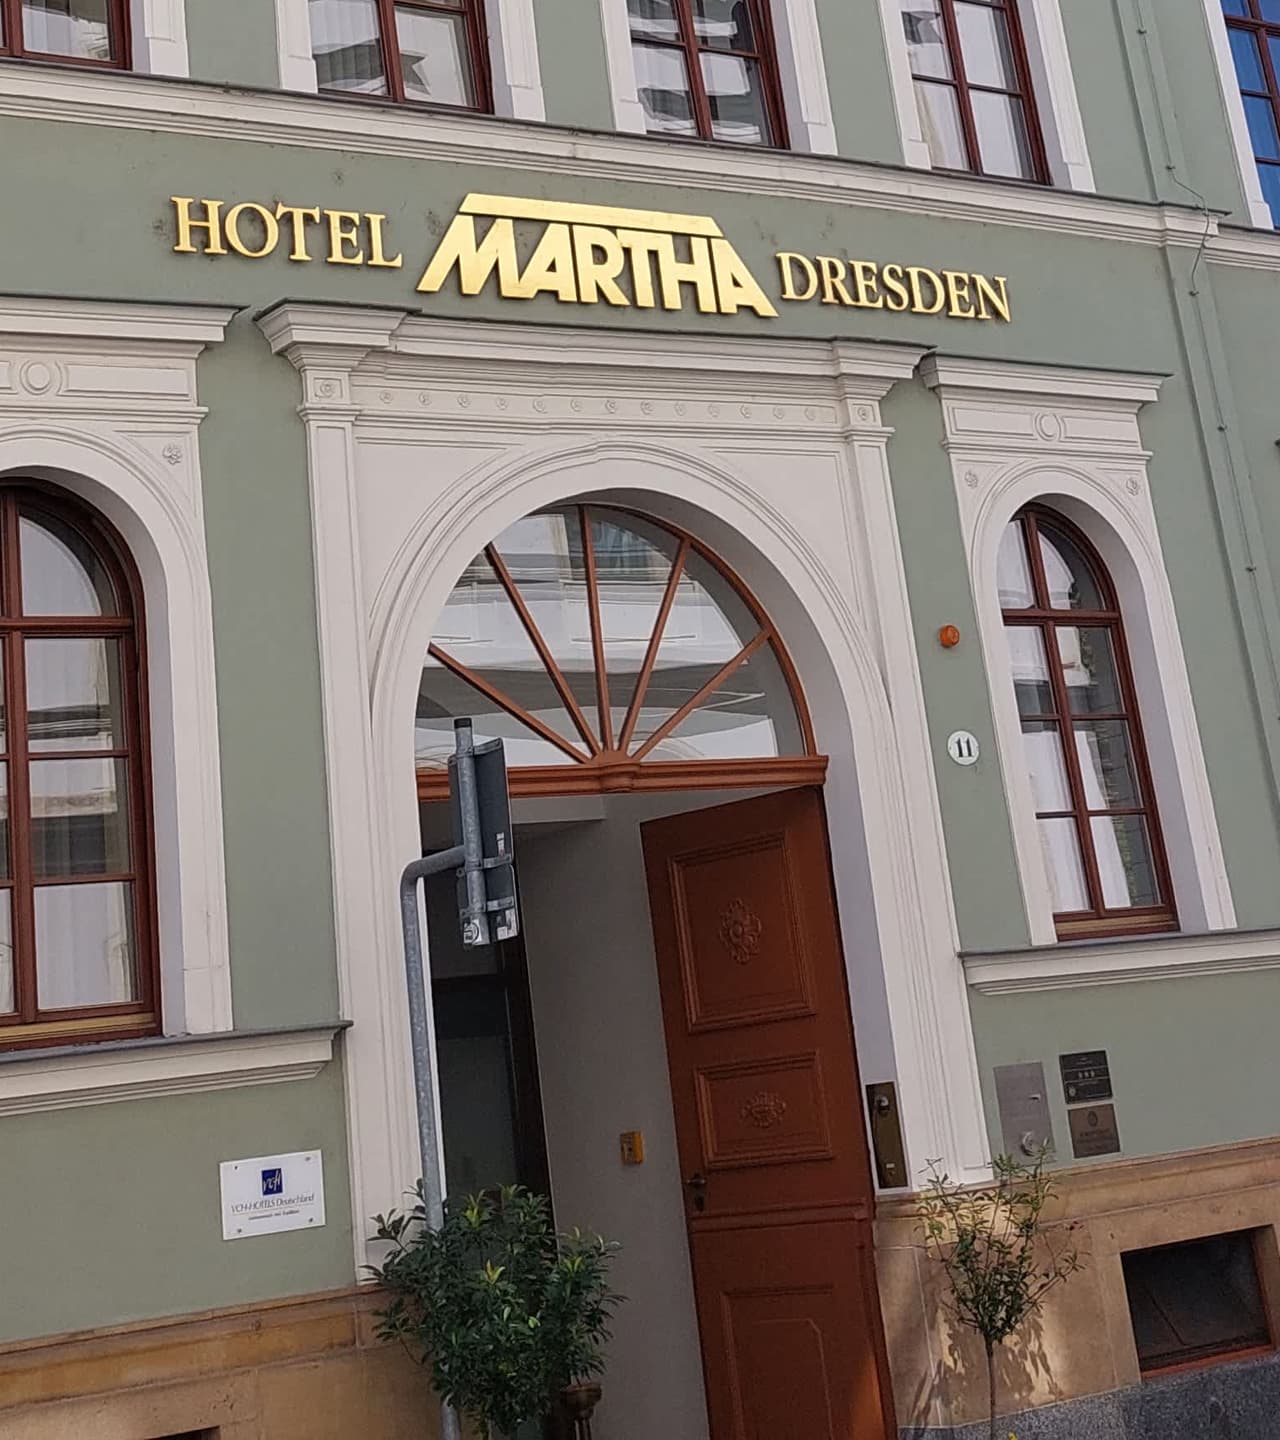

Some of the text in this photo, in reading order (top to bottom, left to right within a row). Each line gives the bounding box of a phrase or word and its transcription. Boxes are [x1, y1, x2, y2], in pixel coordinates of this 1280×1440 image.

[170, 195, 1012, 323] HOTEL MARTHA DRESDEN
[954, 737, 973, 758] 11
